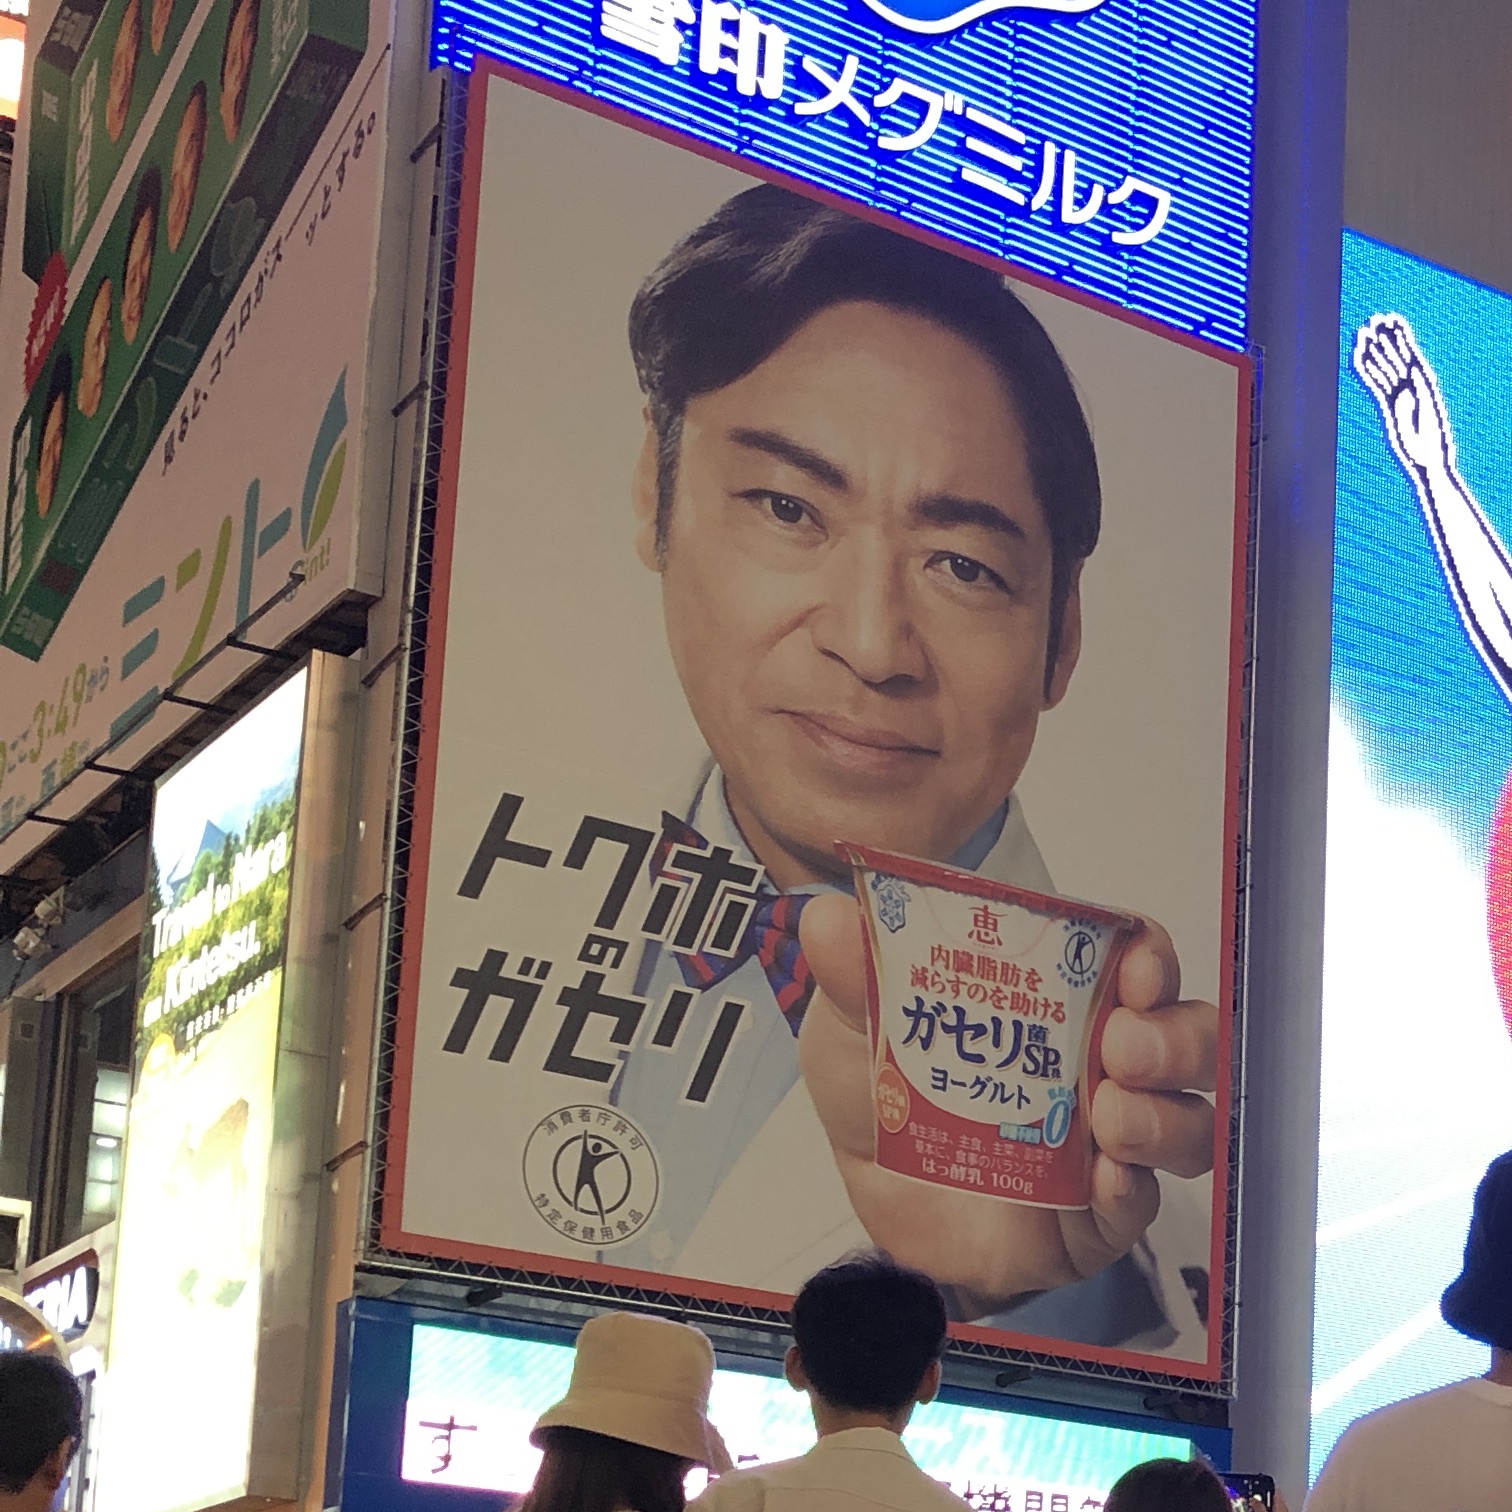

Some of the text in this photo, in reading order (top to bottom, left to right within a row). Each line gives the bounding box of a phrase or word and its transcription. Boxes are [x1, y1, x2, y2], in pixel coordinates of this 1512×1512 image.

[456, 791, 758, 952] トクホ
[967, 904, 1007, 947] 恵
[576, 933, 630, 970] の
[930, 944, 1043, 993] 内臓脂肪を
[909, 963, 1067, 1024] 減らすのを助ける
[442, 948, 746, 1103] ガセリ
[930, 1066, 1031, 1110] ヨーグルト
[540, 1107, 645, 1151] 消費者庁許可
[922, 1157, 1034, 1196] はっ酵乳 100g
[534, 1192, 645, 1241] 特定保健用食品
